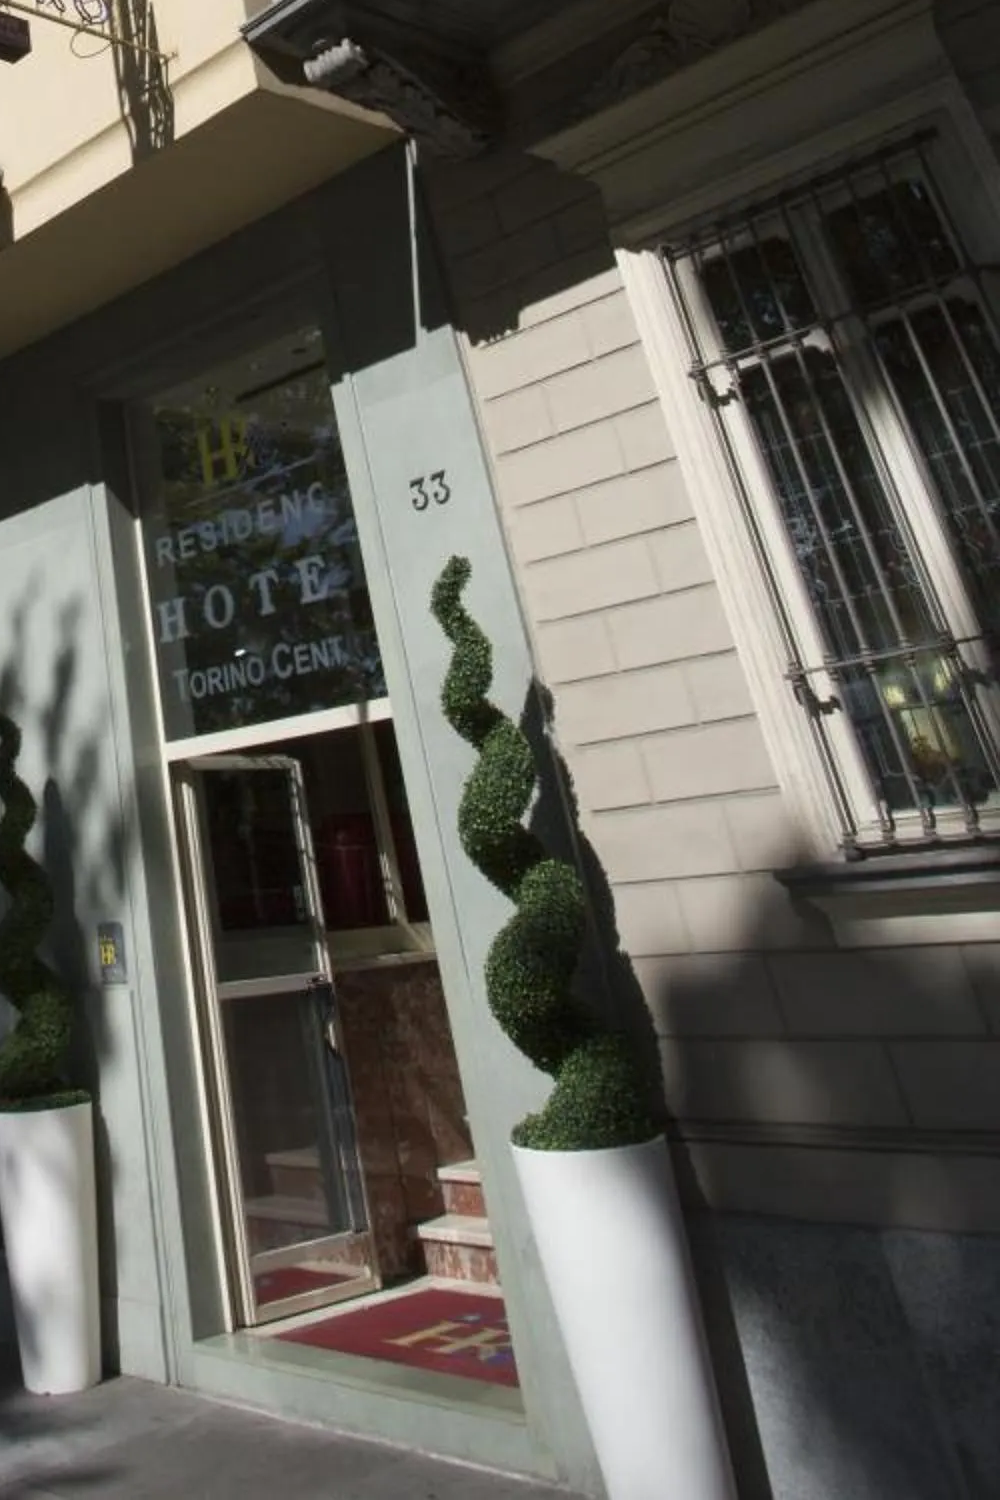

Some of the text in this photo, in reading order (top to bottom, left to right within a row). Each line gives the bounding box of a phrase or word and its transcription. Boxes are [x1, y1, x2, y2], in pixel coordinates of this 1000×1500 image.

[154, 481, 326, 568] RESIDENC
[407, 469, 451, 512] 33
[157, 554, 329, 644] HOTE
[173, 635, 350, 702] TORINO CENT
